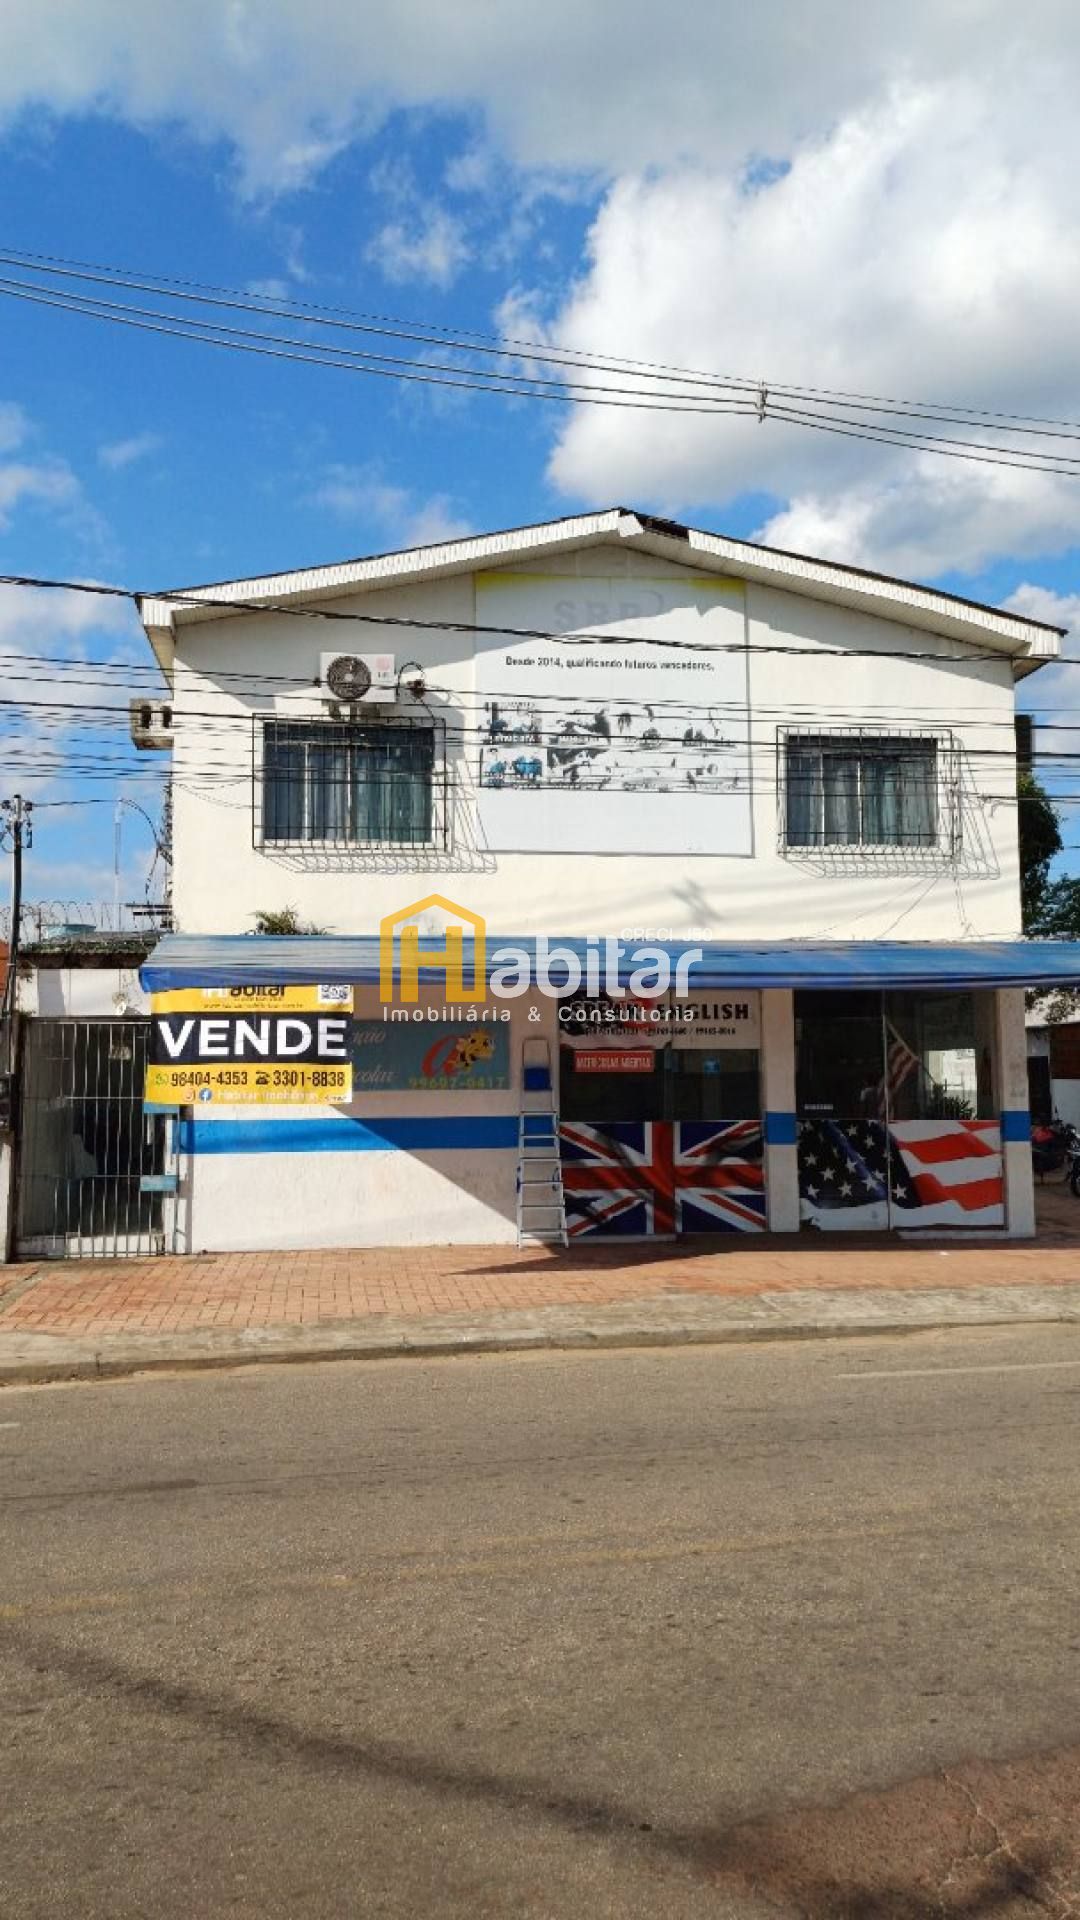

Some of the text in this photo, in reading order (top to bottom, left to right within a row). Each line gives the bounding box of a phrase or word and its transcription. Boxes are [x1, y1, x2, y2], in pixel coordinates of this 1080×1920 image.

[158, 1019, 347, 1058] VENDE
[171, 1070, 345, 1087] 98404-4353 3301-8838
